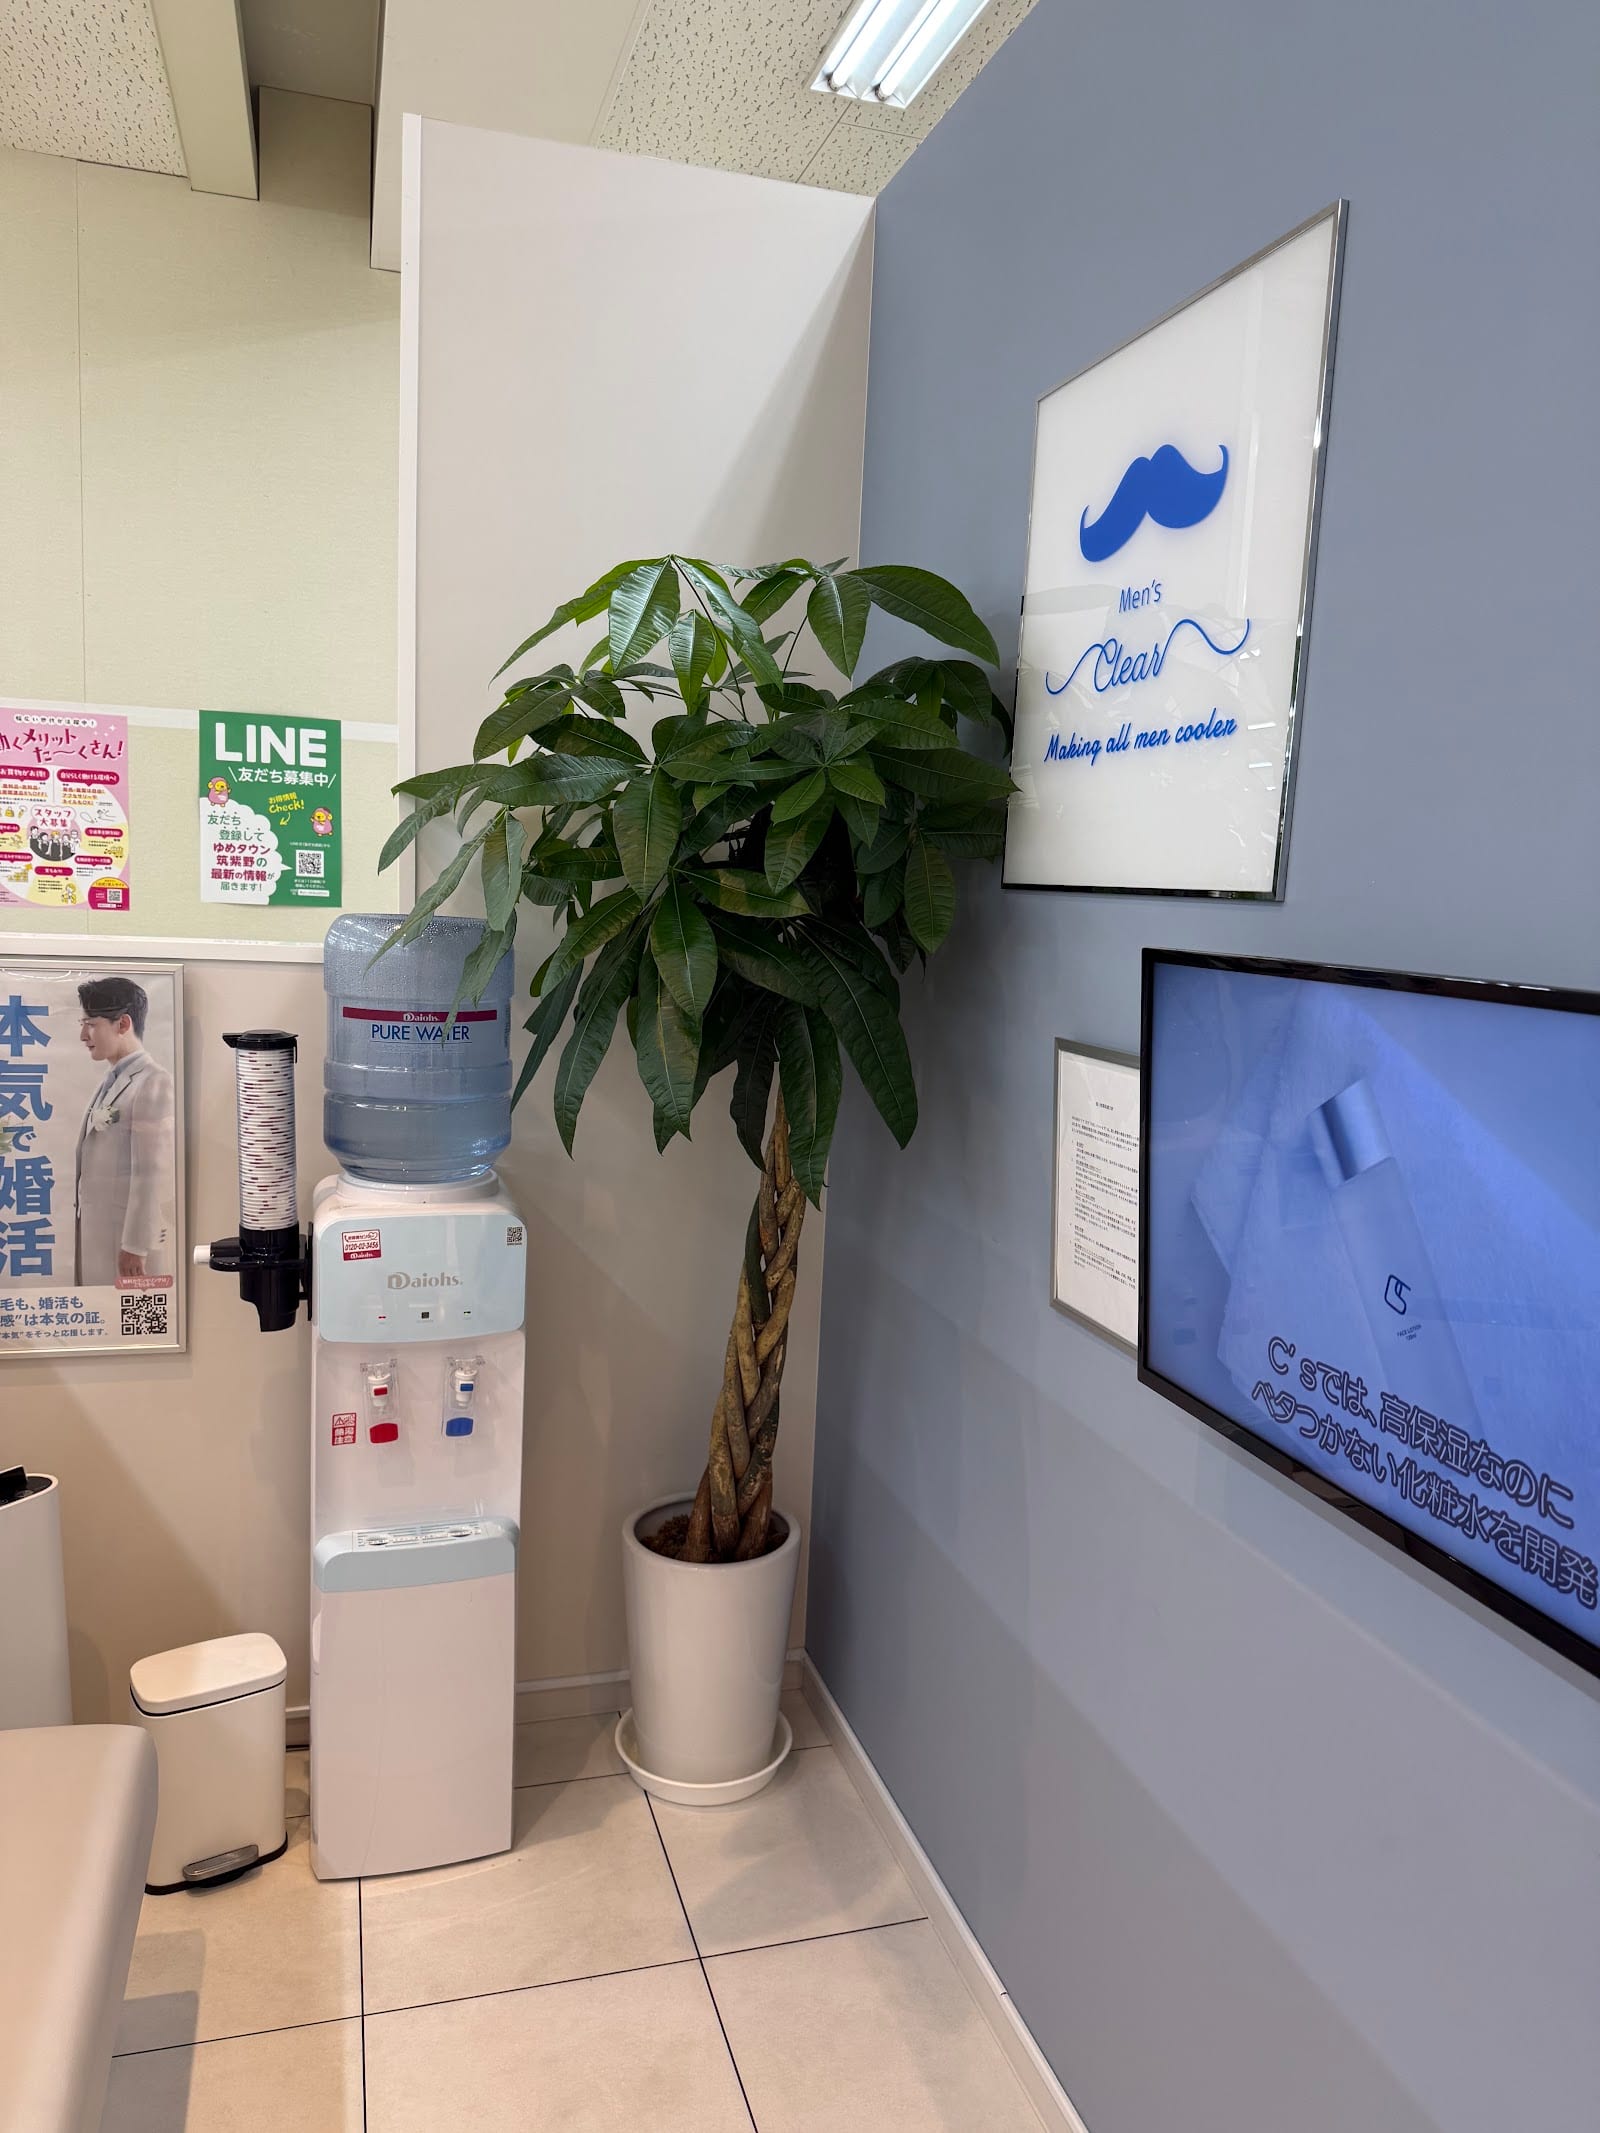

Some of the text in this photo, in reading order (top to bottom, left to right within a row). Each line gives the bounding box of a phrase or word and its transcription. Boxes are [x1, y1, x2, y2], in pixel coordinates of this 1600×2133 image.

[1119, 579, 1162, 614] Men's
[1044, 707, 1238, 766] Making all men cooler
[215, 722, 327, 768] LINE
[238, 767, 329, 787] 友だち募集中
[34, 808, 72, 817] スタッフ
[269, 800, 305, 814] Check!
[39, 819, 68, 827] 大募集
[208, 814, 242, 826] 友だち
[218, 829, 265, 842] 登録して
[213, 843, 271, 855] ゆめタウン
[216, 854, 268, 868] 筑紫野の
[211, 868, 275, 882] 最新の情報が
[372, 1024, 411, 1040] PURE
[0, 995, 56, 1278] 本気で婚活
[0, 1296, 84, 1311] 毛も、婚活も
[1252, 1380, 1600, 1610] ベタつかない化粧水を開発
